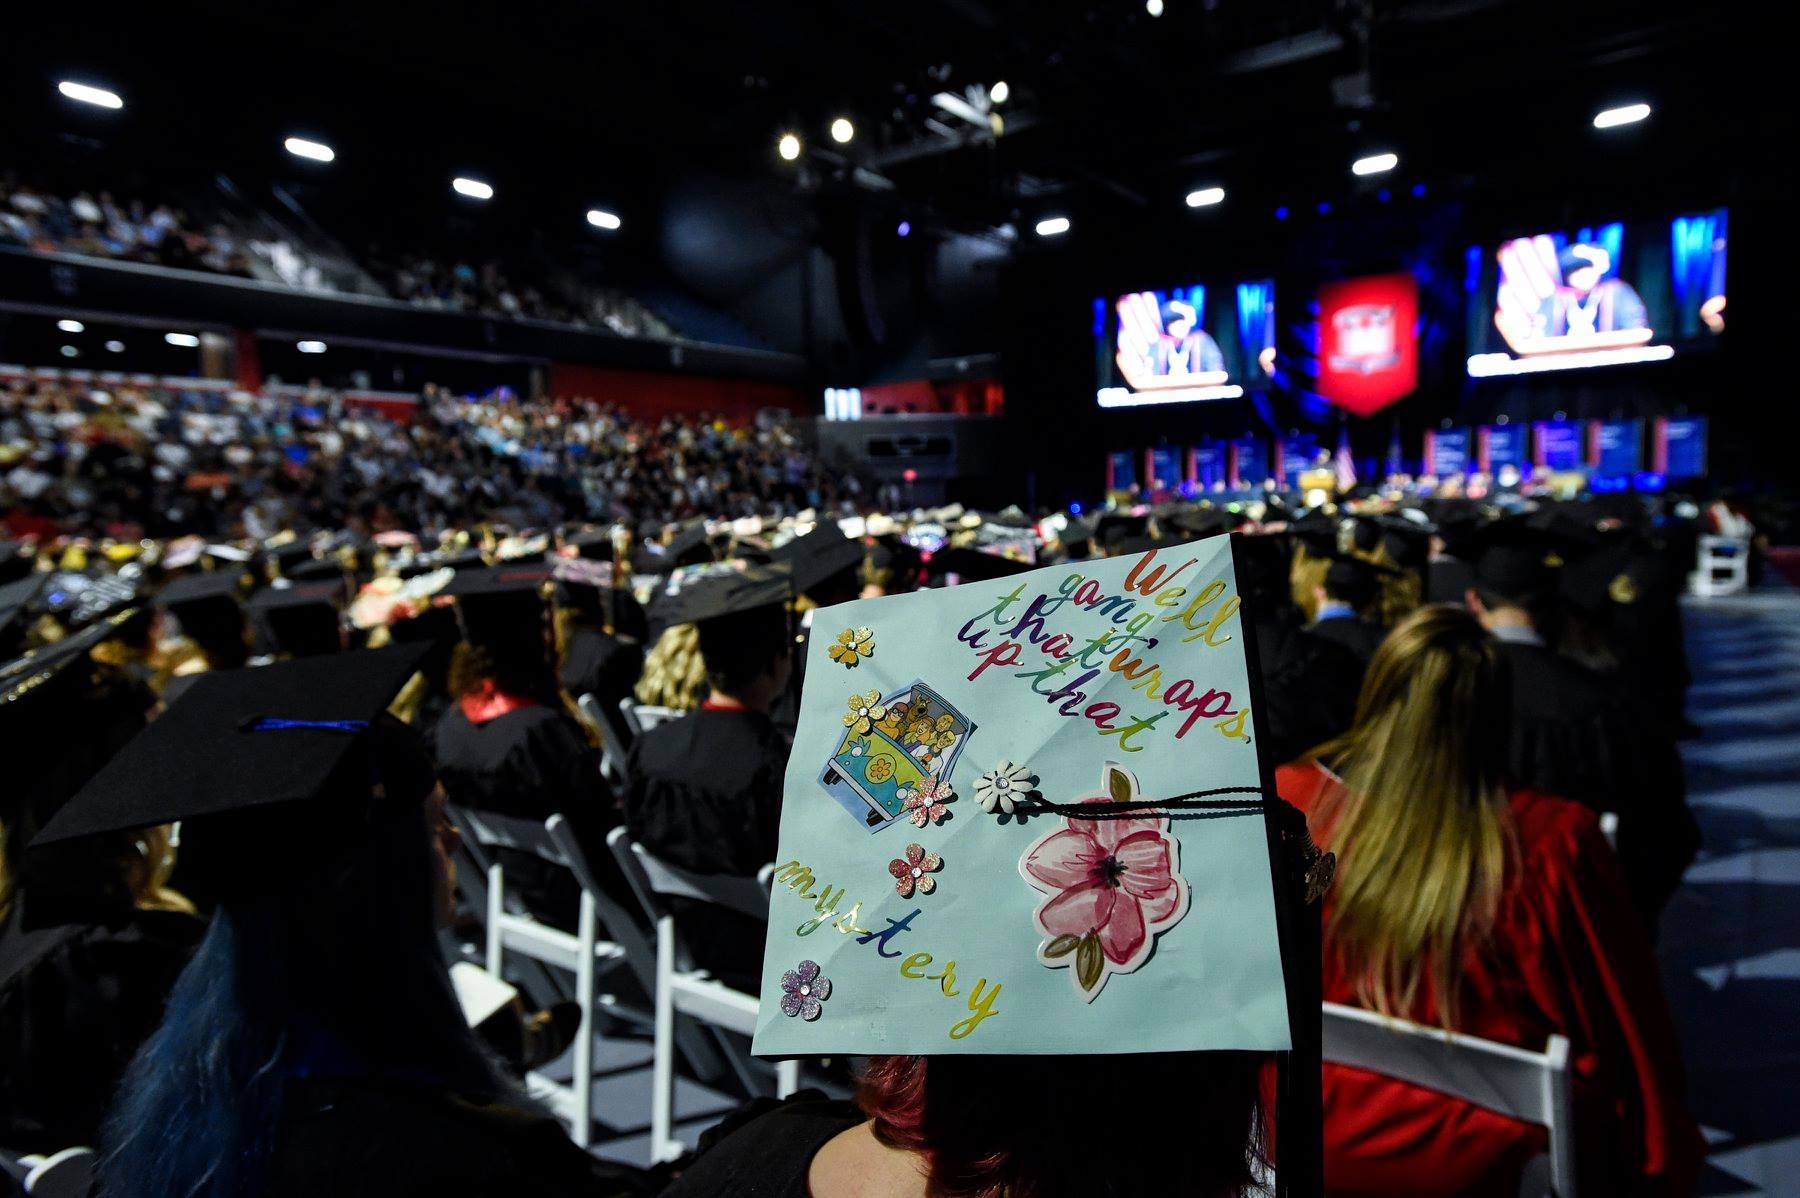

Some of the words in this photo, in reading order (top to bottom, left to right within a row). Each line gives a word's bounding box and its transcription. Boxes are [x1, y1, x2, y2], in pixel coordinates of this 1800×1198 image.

[974, 583, 1116, 670] that
[1109, 648, 1251, 744] wraps
[1123, 549, 1242, 647] Well
[958, 619, 1024, 681] up
[1015, 658, 1169, 752] that
[774, 860, 1002, 1039] mystery
